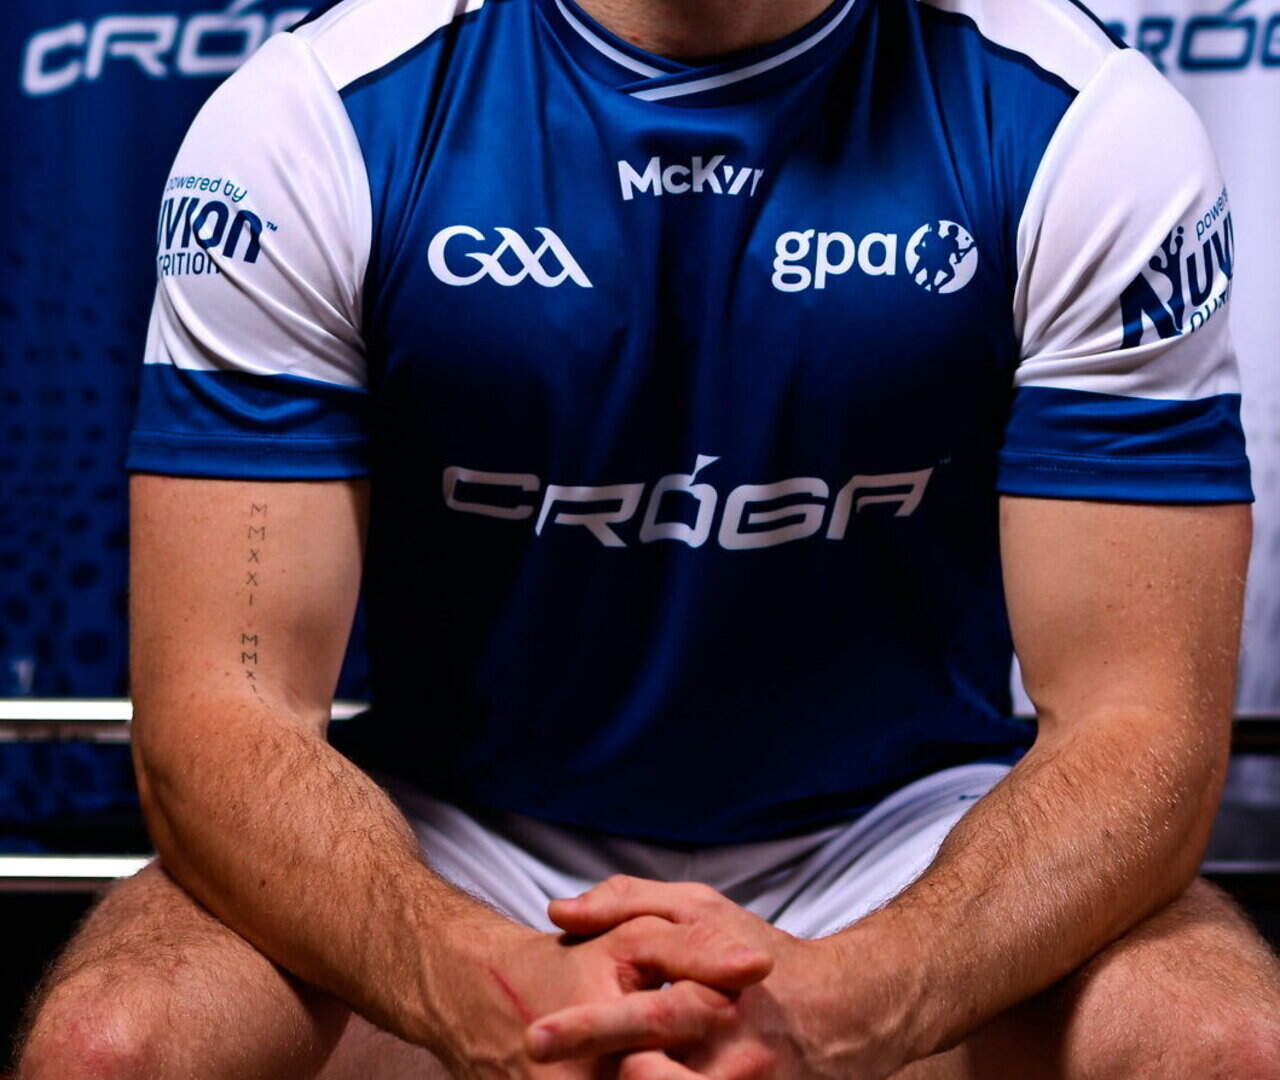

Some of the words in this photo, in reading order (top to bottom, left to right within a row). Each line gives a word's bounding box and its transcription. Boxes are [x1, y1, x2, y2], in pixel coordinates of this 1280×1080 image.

[167, 176, 222, 194] owered
[223, 180, 247, 203] by
[427, 224, 594, 288] GAA
[771, 228, 898, 294] gpa
[442, 454, 933, 550] CRÓGA
